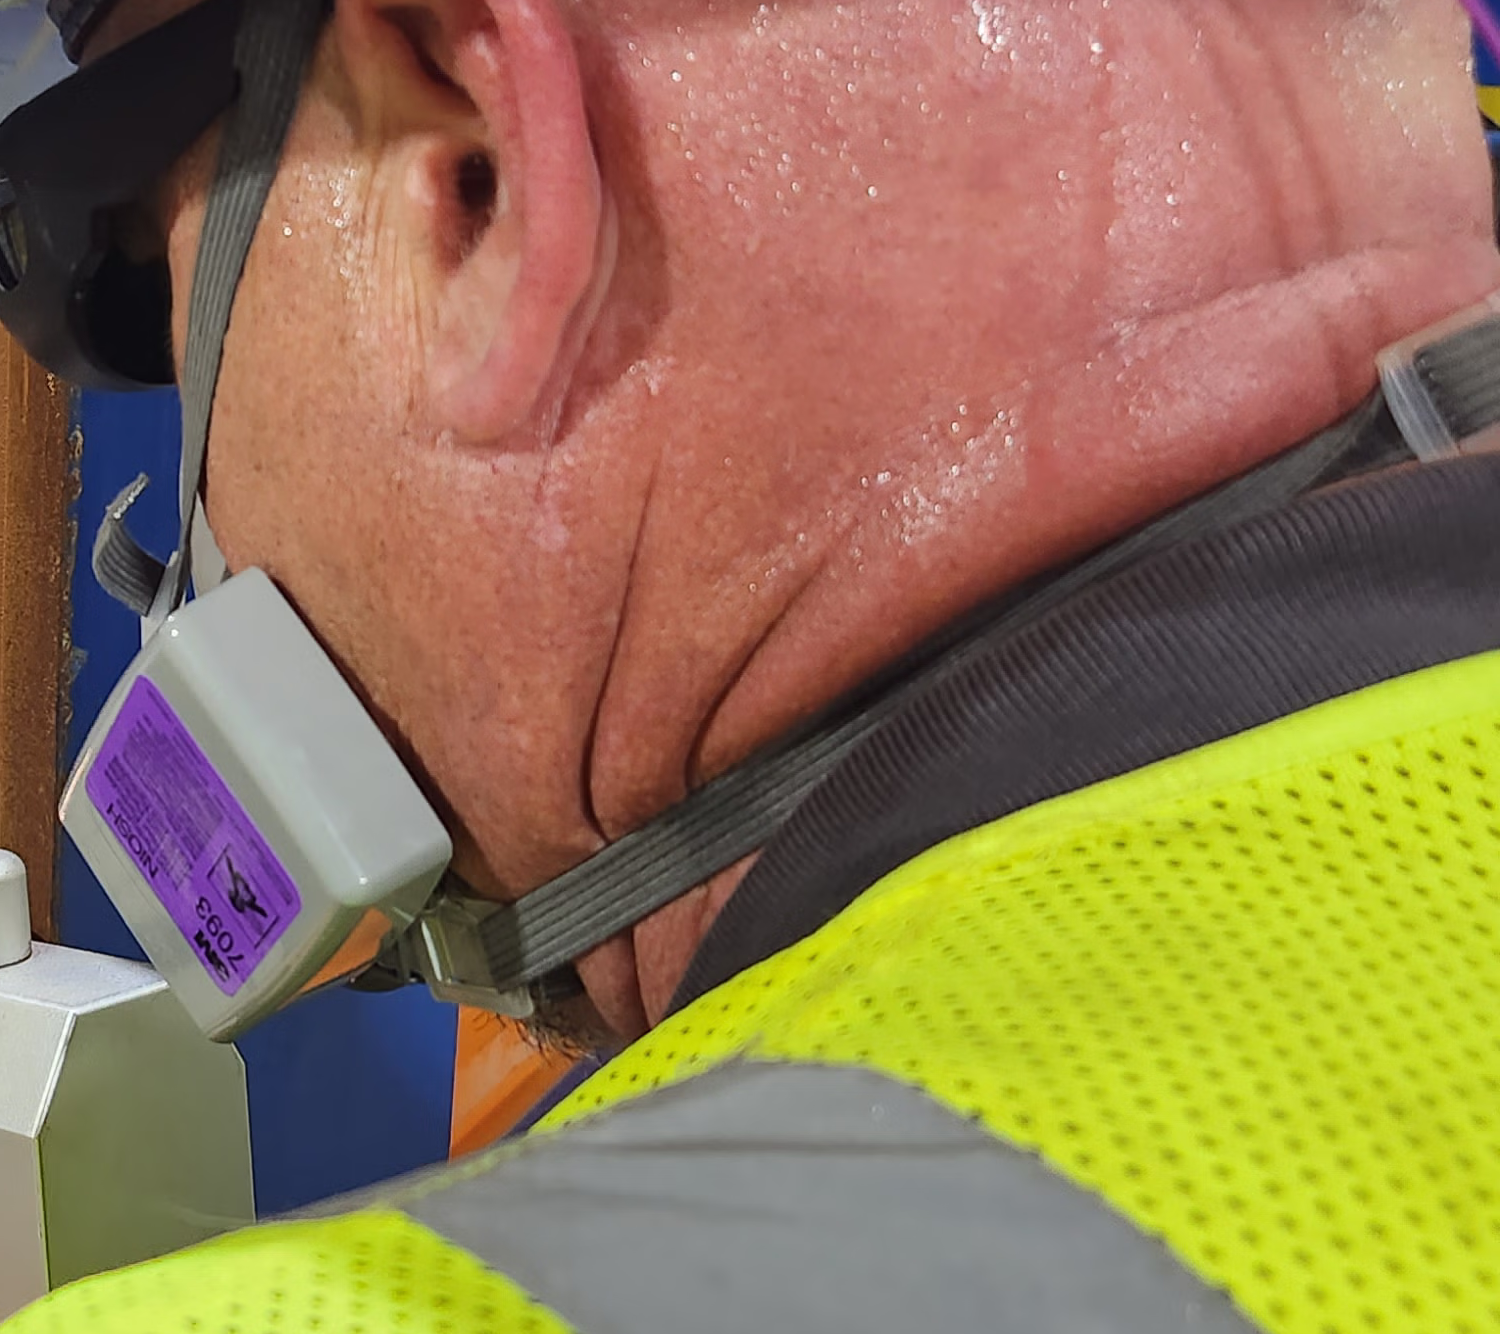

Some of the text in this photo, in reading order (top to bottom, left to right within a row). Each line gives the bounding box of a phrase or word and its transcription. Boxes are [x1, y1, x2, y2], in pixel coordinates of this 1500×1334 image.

[106, 803, 159, 878] NIOSH
[194, 928, 231, 983] 3M
[195, 896, 244, 973] 7093
